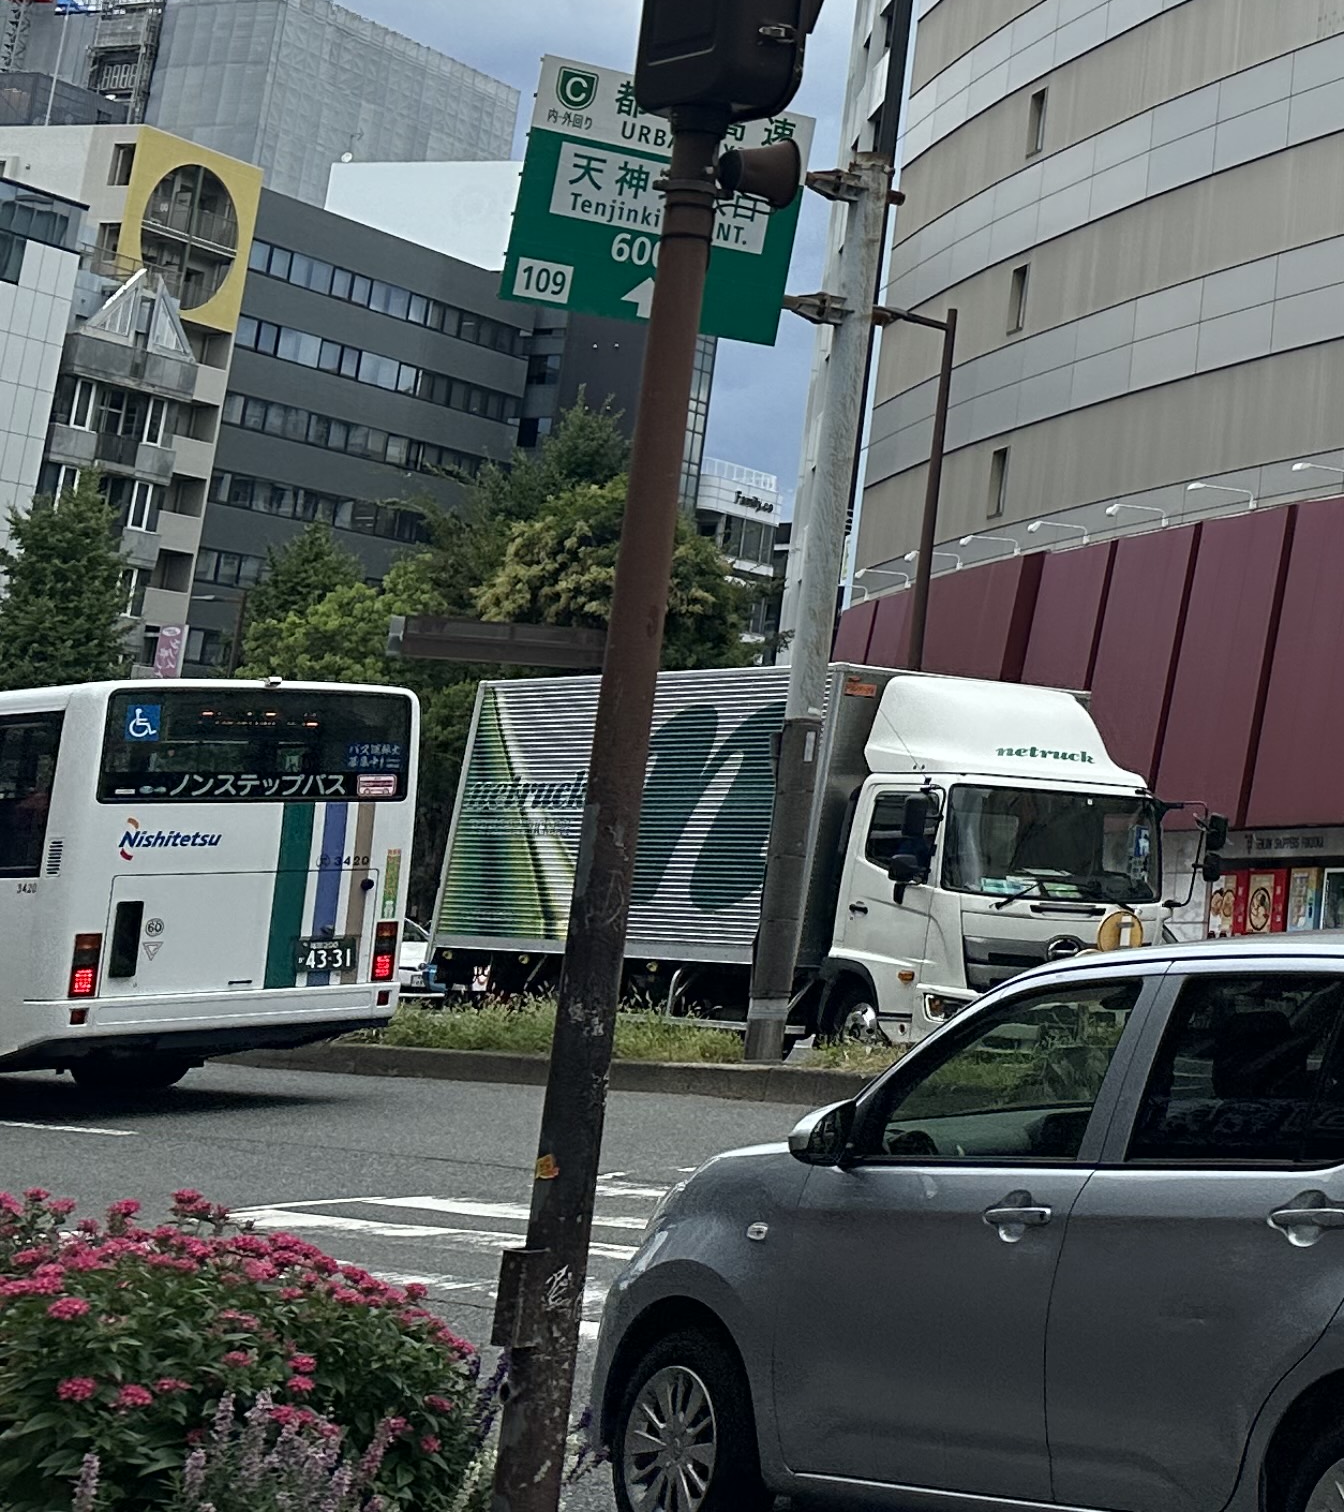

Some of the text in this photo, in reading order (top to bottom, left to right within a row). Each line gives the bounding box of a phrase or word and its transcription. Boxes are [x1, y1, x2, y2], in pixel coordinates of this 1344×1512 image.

[522, 265, 567, 296] 109
[996, 746, 1095, 765] netruck
[169, 773, 346, 797] ノンステップバス
[118, 830, 222, 848] Nishitetsu
